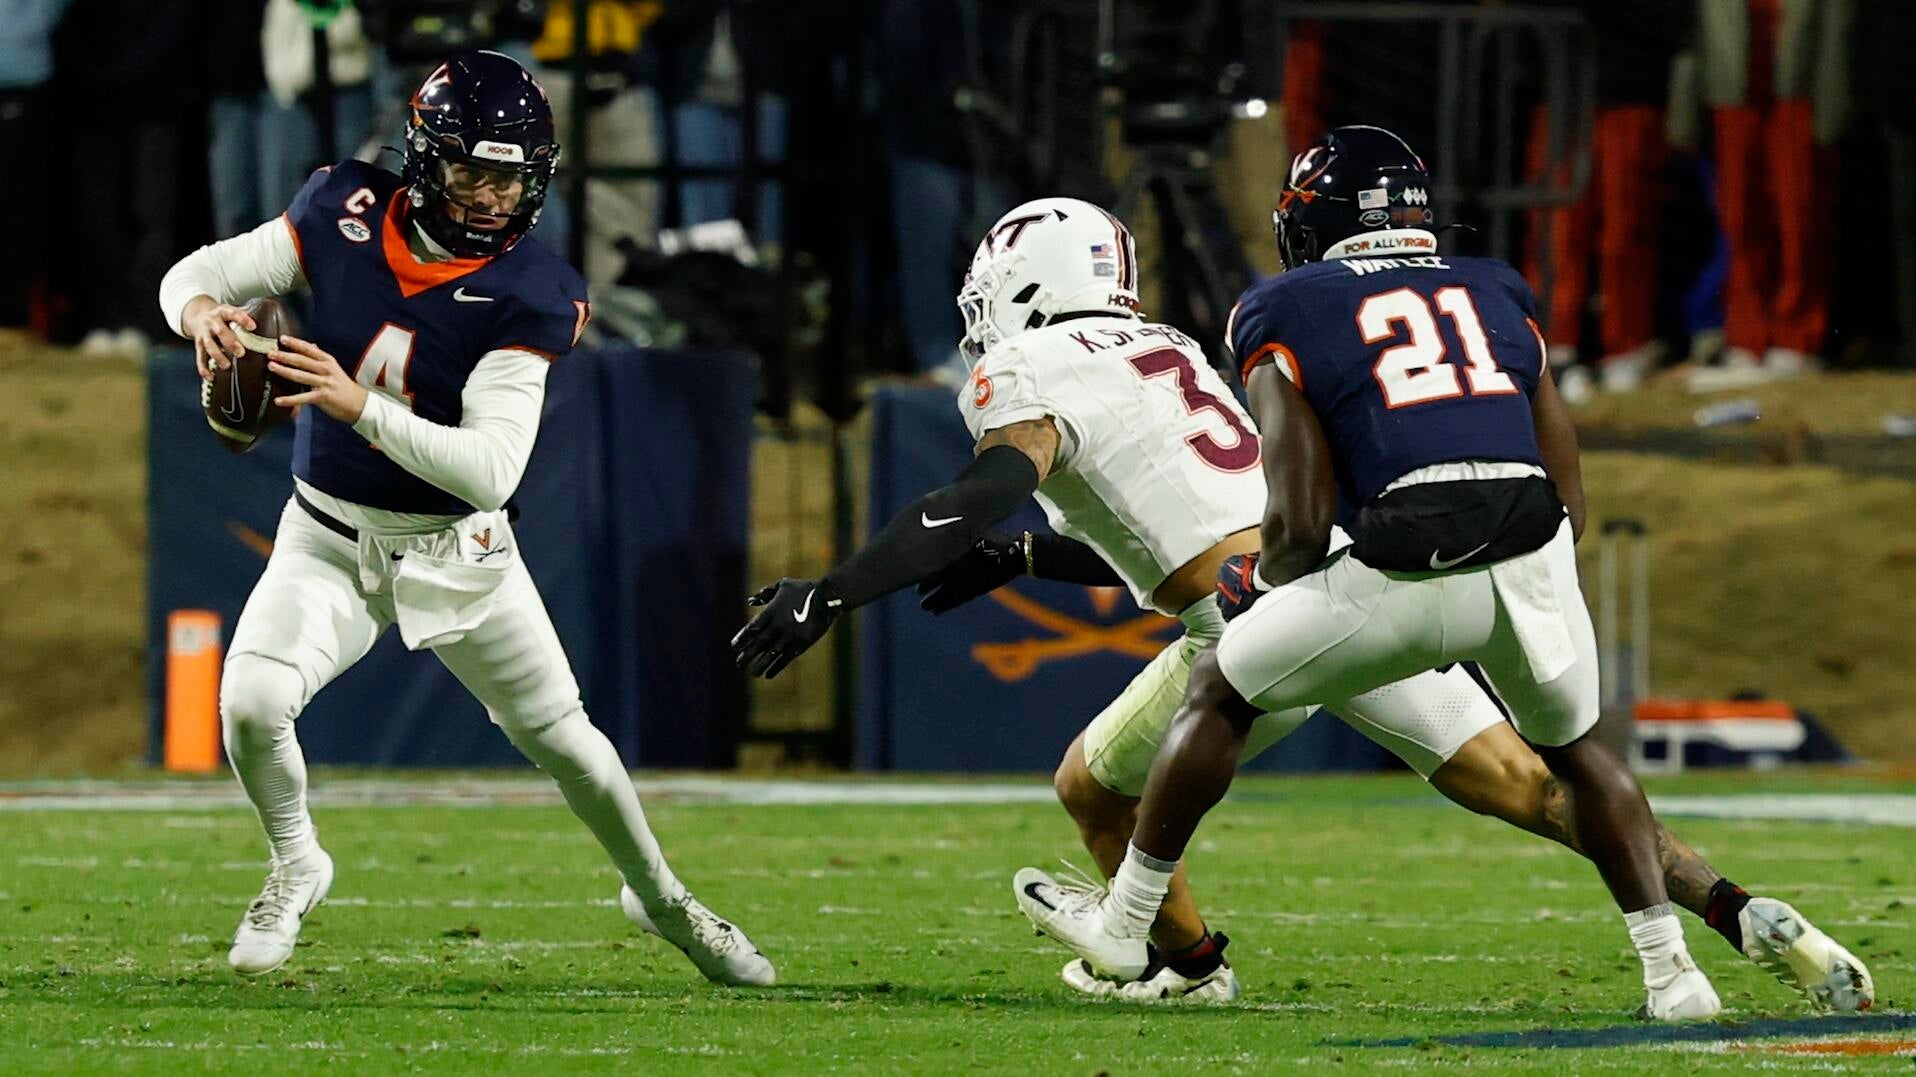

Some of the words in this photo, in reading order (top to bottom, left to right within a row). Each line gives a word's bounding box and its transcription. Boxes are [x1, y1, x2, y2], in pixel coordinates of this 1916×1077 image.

[344, 187, 377, 215] C
[341, 222, 369, 239] ACC
[1343, 240, 1370, 254] FOR
[1373, 238, 1395, 249] ALL
[1107, 294, 1141, 311] HOK
[1356, 284, 1520, 410] 21
[352, 319, 417, 414] 4
[1125, 345, 1263, 474] 3
